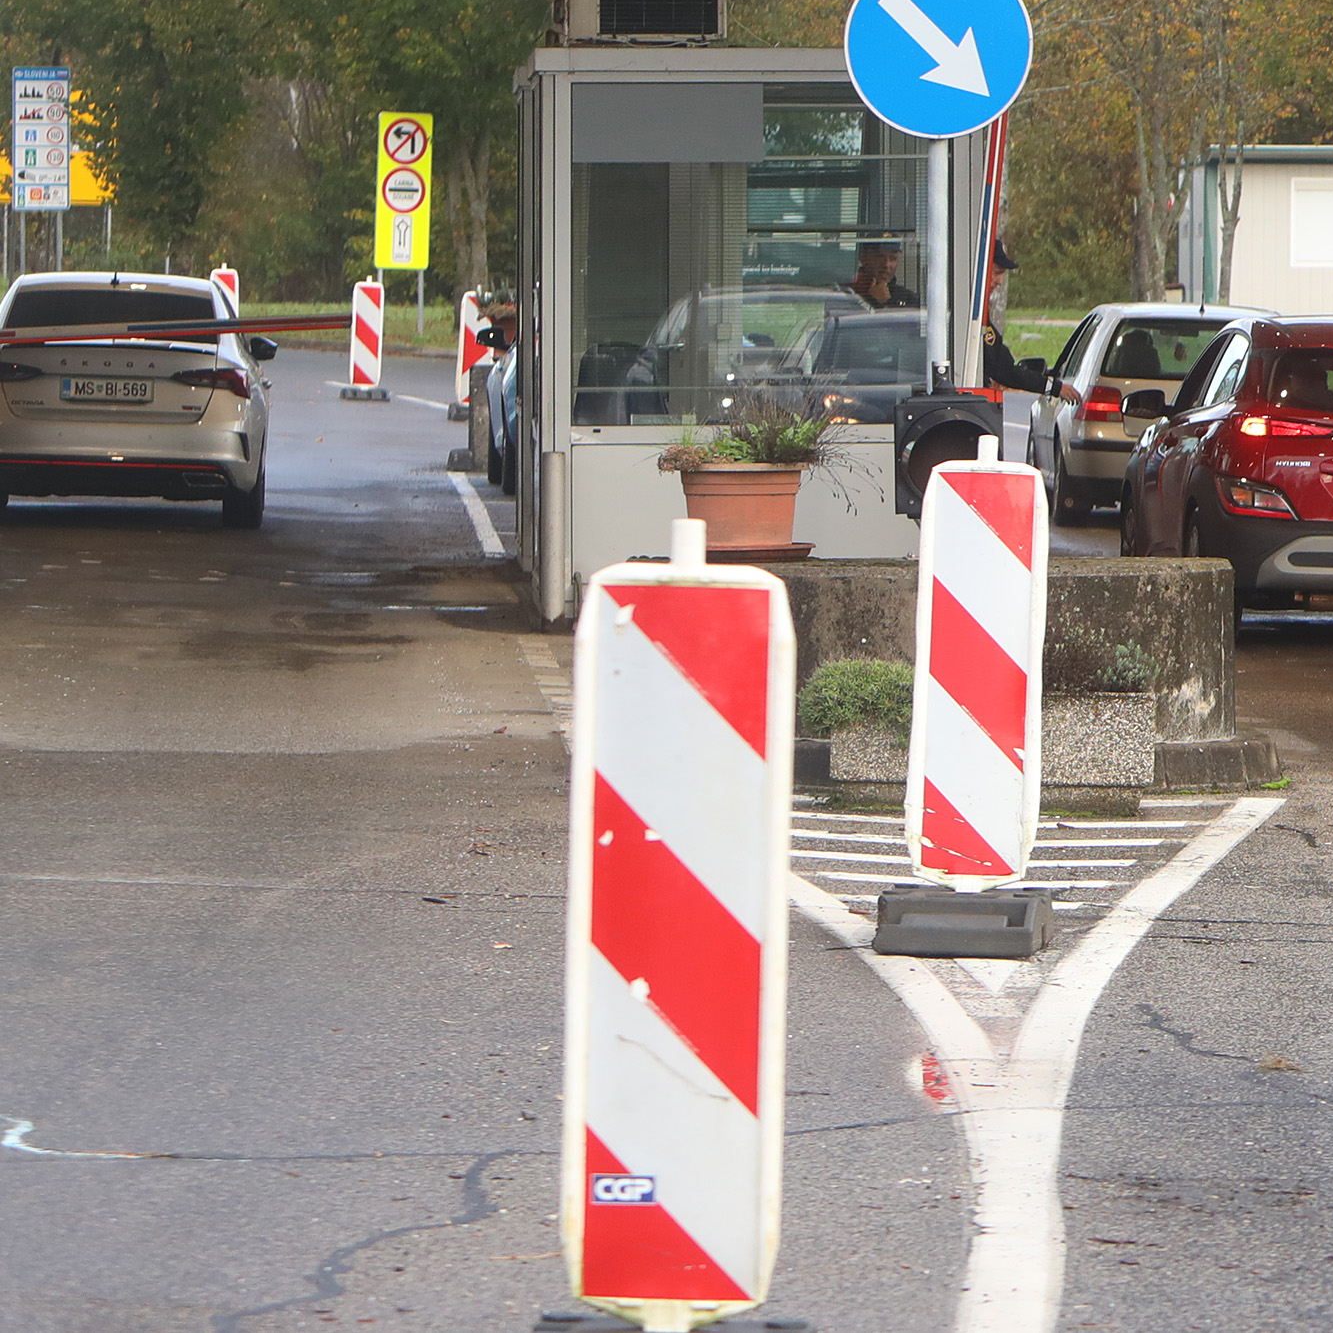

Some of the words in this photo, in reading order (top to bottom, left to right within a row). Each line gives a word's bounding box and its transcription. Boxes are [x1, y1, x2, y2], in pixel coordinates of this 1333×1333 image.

[75, 382, 95, 395] MS
[105, 382, 147, 397] BI-569
[594, 1177, 654, 1202] CGP
